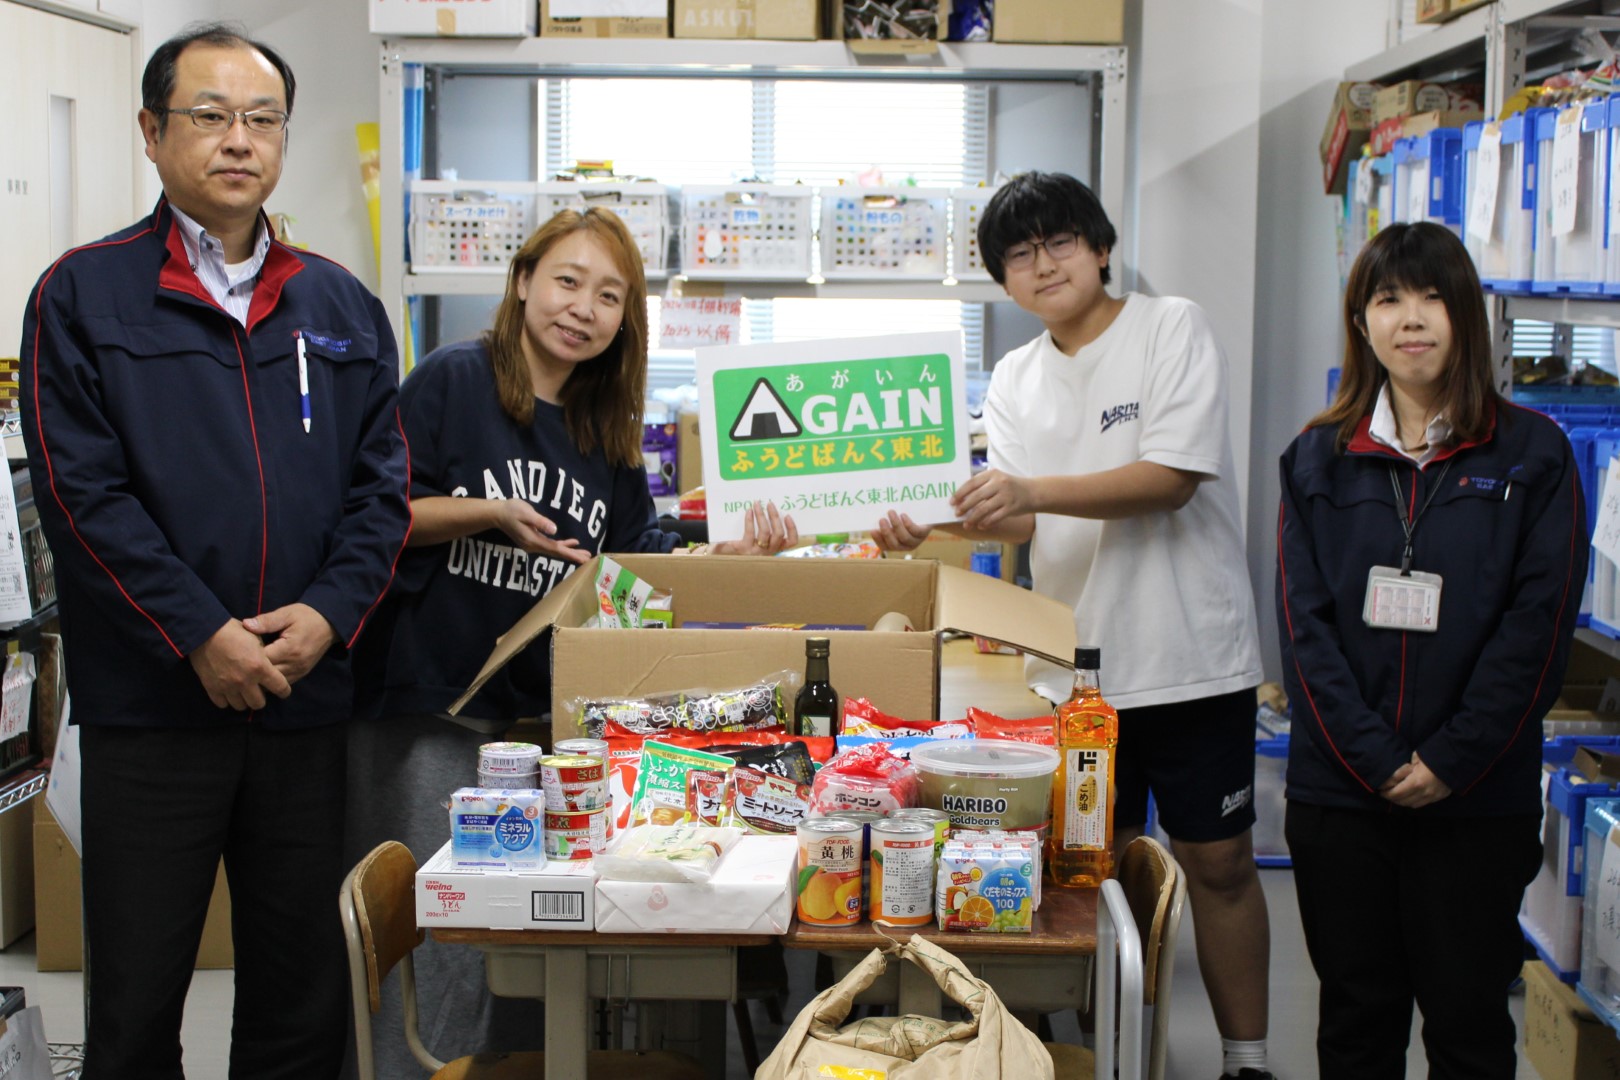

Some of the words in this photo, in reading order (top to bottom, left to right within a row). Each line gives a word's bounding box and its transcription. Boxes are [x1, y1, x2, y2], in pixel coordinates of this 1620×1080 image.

[731, 434, 944, 473] ふうどばんく東北
[577, 766, 600, 780] さば
[834, 793, 881, 808] ホンコン
[942, 795, 1007, 814] HARIBO
[742, 796, 804, 819] ミートソース
[950, 815, 1000, 826] Goldbears
[500, 822, 532, 833] ミネラル
[502, 833, 528, 844] アクア
[983, 887, 1027, 898] くだものミックス
[441, 900, 461, 909] うどん
[996, 899, 1014, 909] 100
